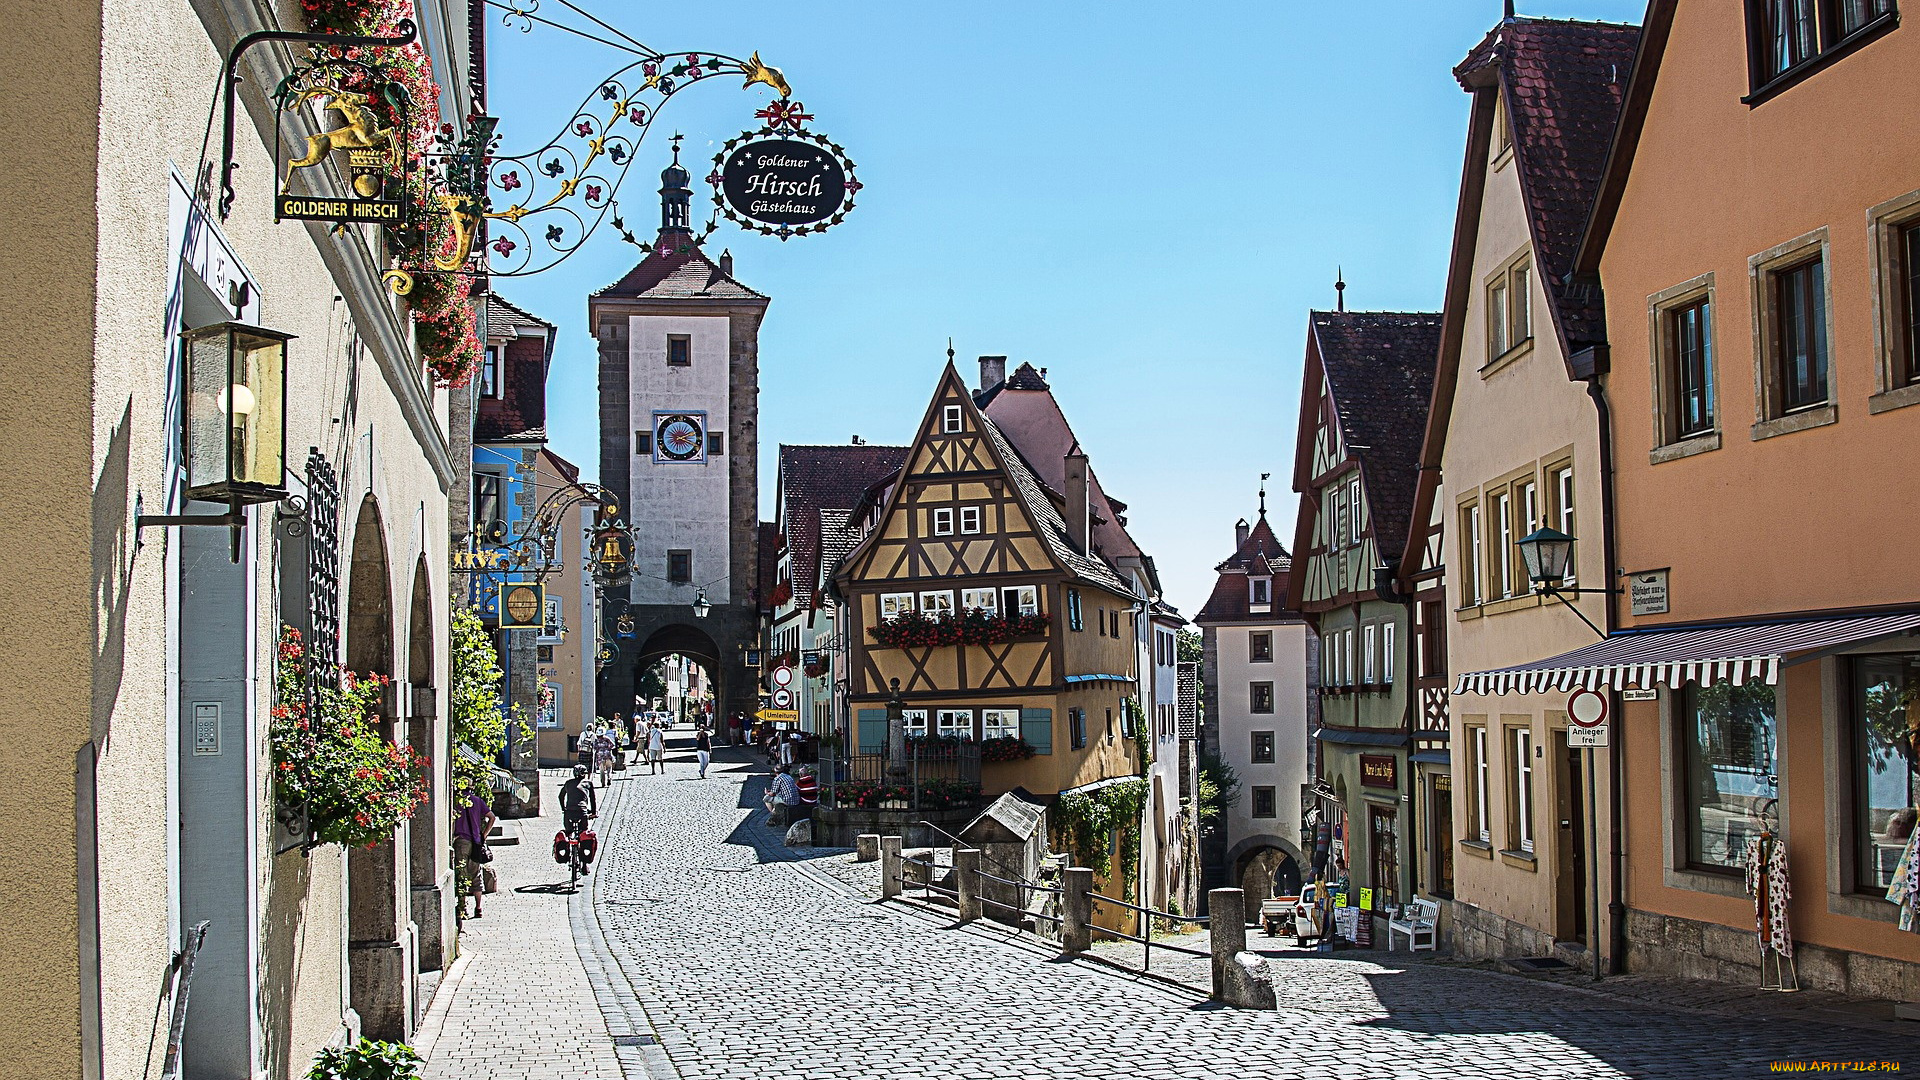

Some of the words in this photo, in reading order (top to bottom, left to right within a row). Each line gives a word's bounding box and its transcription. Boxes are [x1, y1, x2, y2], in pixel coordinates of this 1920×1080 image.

[757, 155, 810, 168] Goldener
[744, 172, 823, 197] Hirsch
[284, 200, 348, 217] GOLDENER
[353, 202, 398, 218] HIRSCH
[750, 200, 817, 215] Gästehaus
[767, 711, 797, 720] Umleitung
[1572, 728, 1604, 737] Anlieger
[1582, 736, 1595, 744] frei
